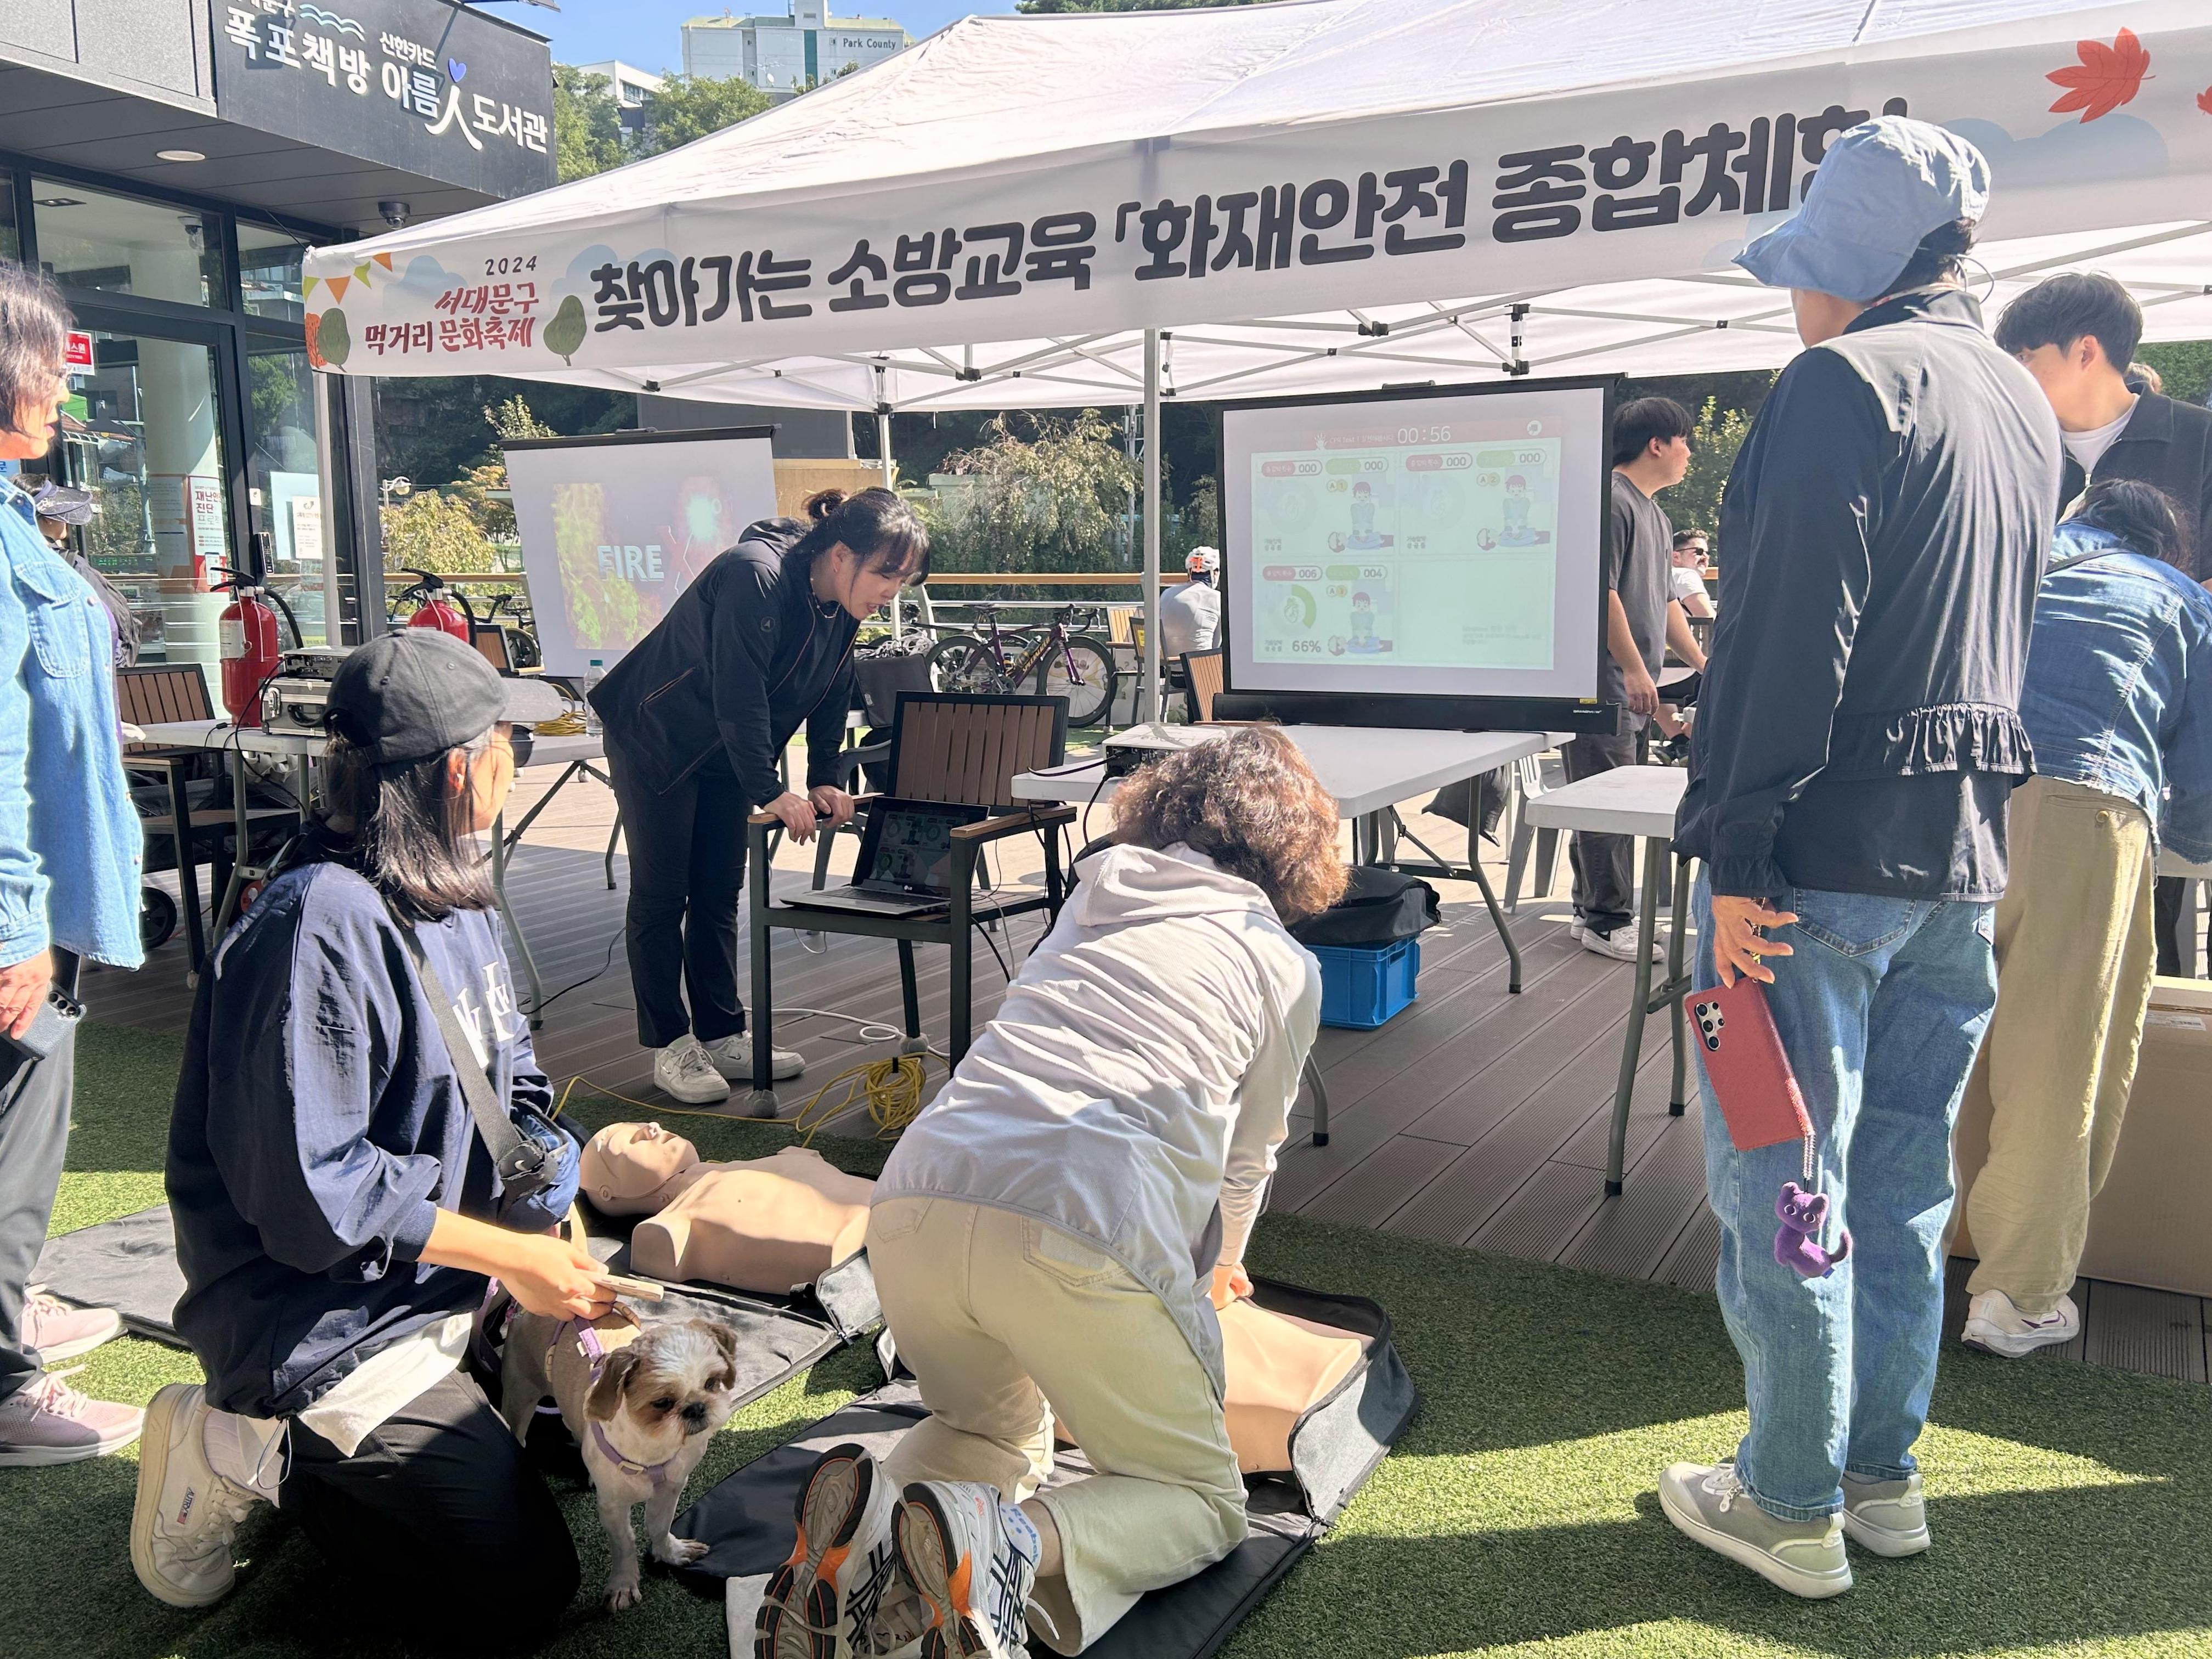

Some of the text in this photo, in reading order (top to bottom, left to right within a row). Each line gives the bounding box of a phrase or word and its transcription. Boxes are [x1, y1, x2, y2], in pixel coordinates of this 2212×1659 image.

[224, 6, 370, 94] 폭포책방
[380, 31, 437, 70] 신한카드
[843, 38, 896, 50] Park County
[590, 249, 813, 332] 찾아가는
[828, 211, 1097, 313] 소방교육
[1115, 159, 1468, 281] 「화재안전
[484, 255, 538, 276] 2024
[434, 282, 539, 315] 서대문구
[364, 316, 537, 356] 먹거리 문화축제
[1397, 425, 1452, 444] 00:56
[1364, 460, 1384, 470] 000
[1446, 456, 1466, 466] 000
[1519, 453, 1541, 463] 000
[1298, 464, 1317, 473] 000
[196, 503, 214, 514] 진단
[597, 545, 664, 582] FIRE
[1363, 568, 1383, 578] 004
[1298, 569, 1317, 578] 006
[1292, 640, 1322, 653] 66%
[183, 1486, 195, 1514] AUTRY
[1011, 1508, 1039, 1564] Reebok
